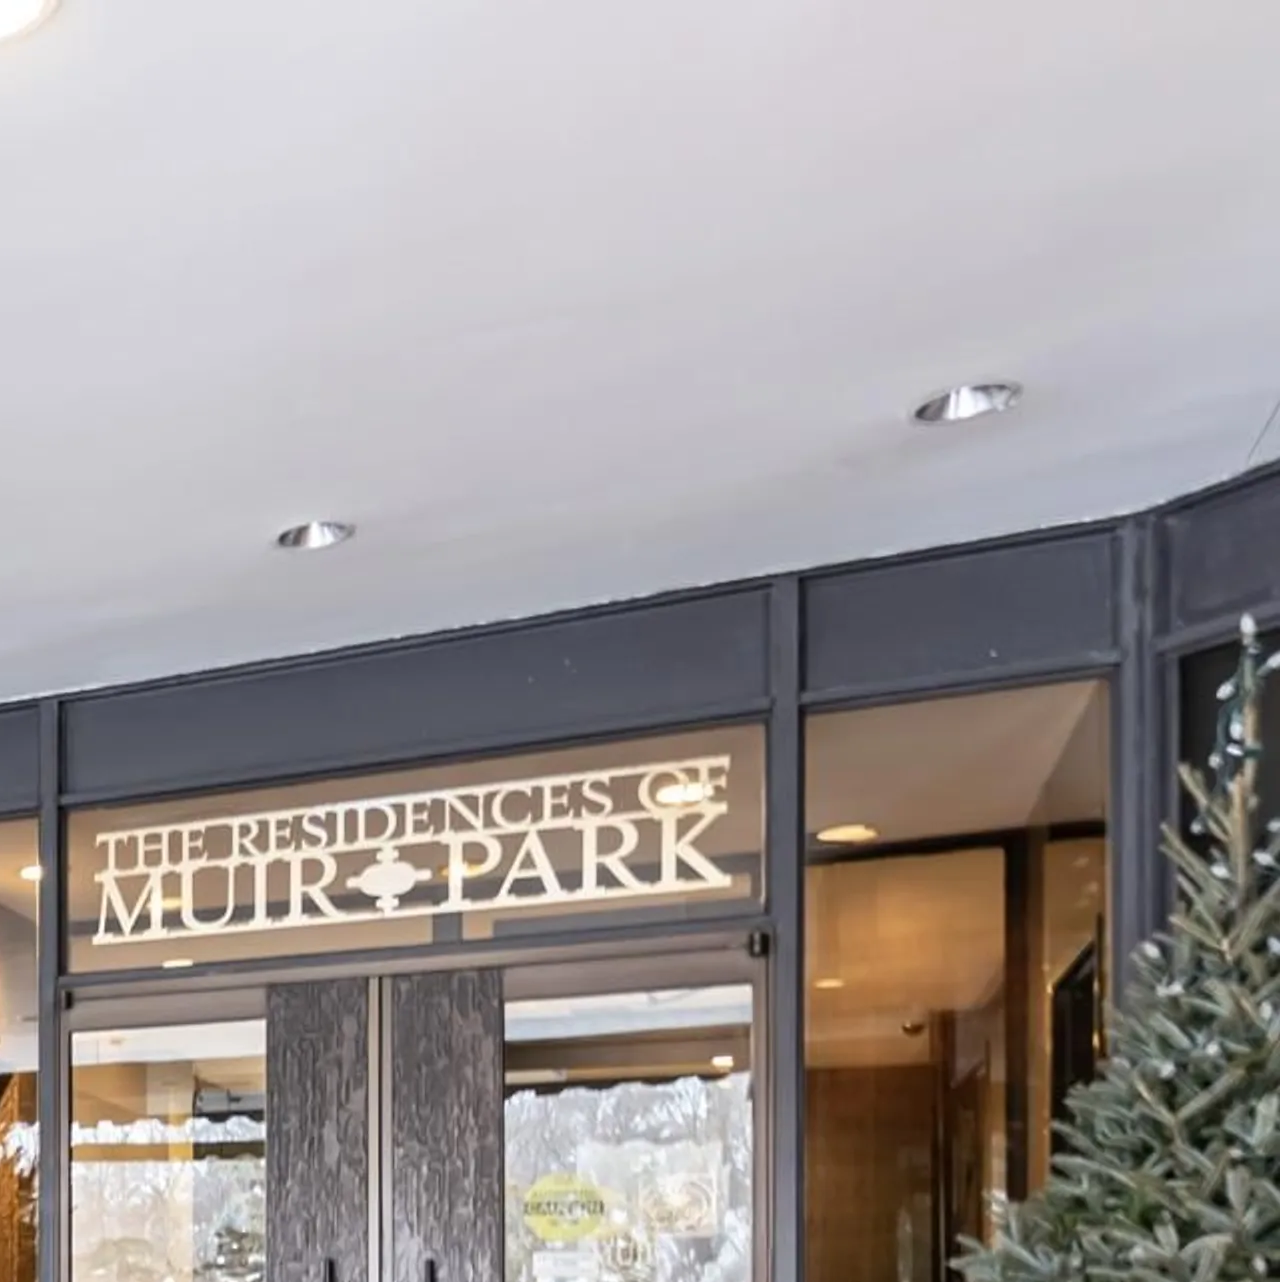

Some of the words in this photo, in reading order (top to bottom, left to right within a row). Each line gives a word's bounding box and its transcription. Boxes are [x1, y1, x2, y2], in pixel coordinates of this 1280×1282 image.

[92, 852, 347, 943] MUIR
[438, 810, 732, 911] PARK
[96, 826, 209, 876] THE
[230, 777, 613, 861] RESIDENCES
[637, 762, 729, 822] OF
